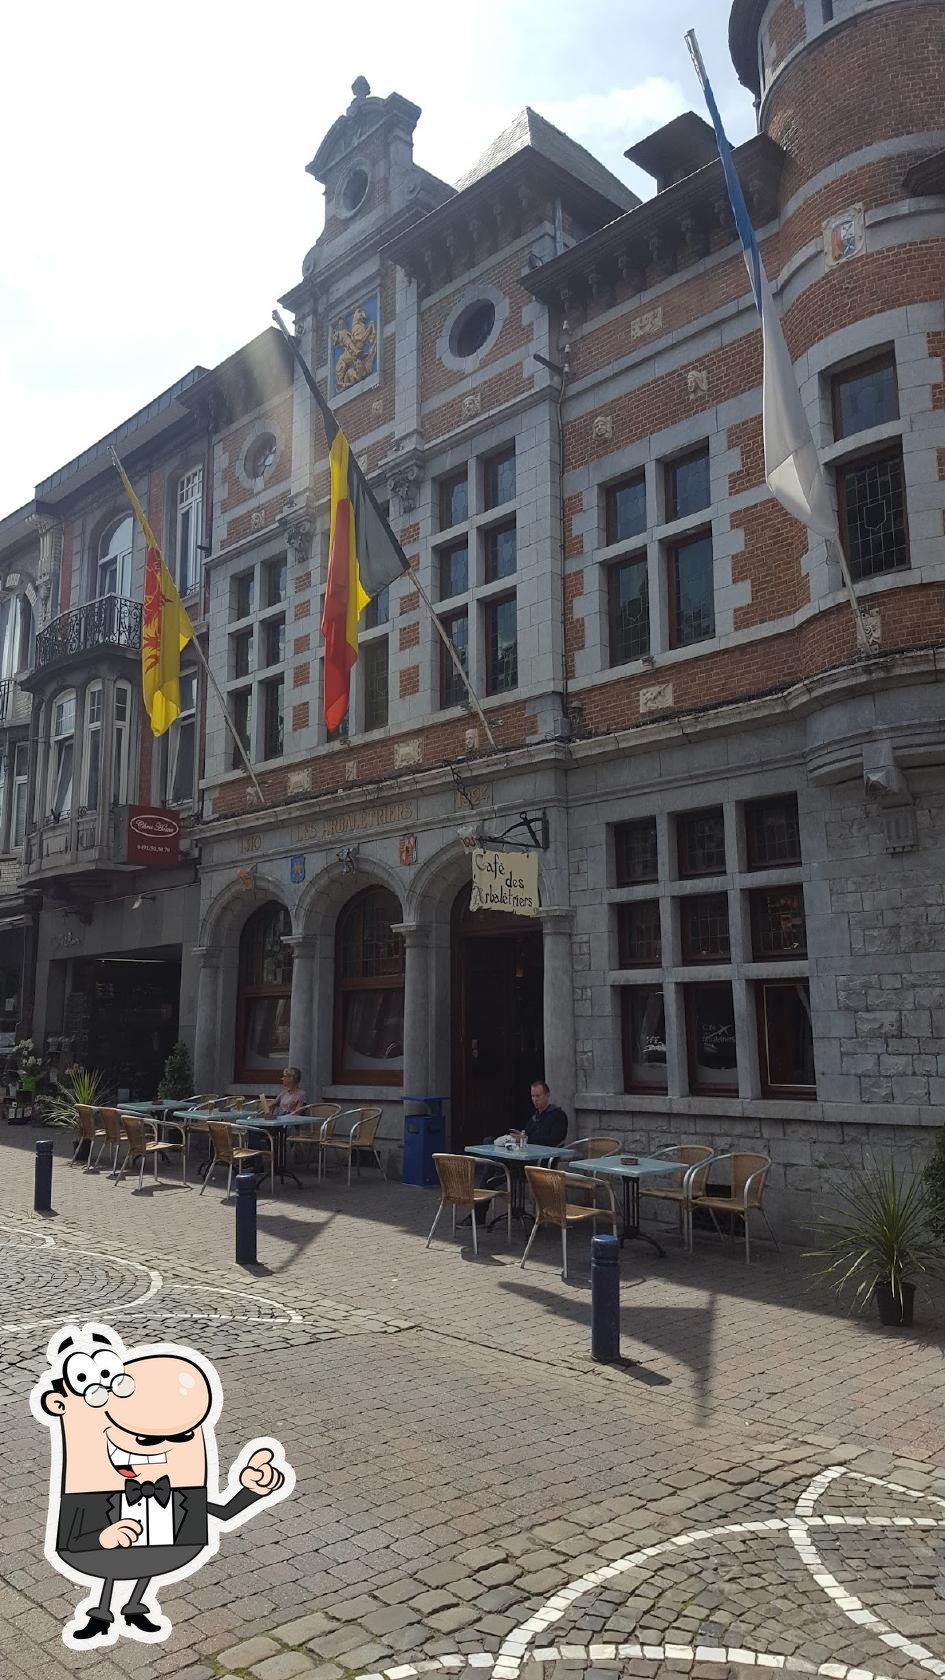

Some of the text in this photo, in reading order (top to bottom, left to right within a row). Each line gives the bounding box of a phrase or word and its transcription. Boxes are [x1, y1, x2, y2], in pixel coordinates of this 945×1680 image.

[475, 853, 505, 878] Café
[505, 871, 525, 889] des
[472, 884, 533, 907] Arbalétriers
